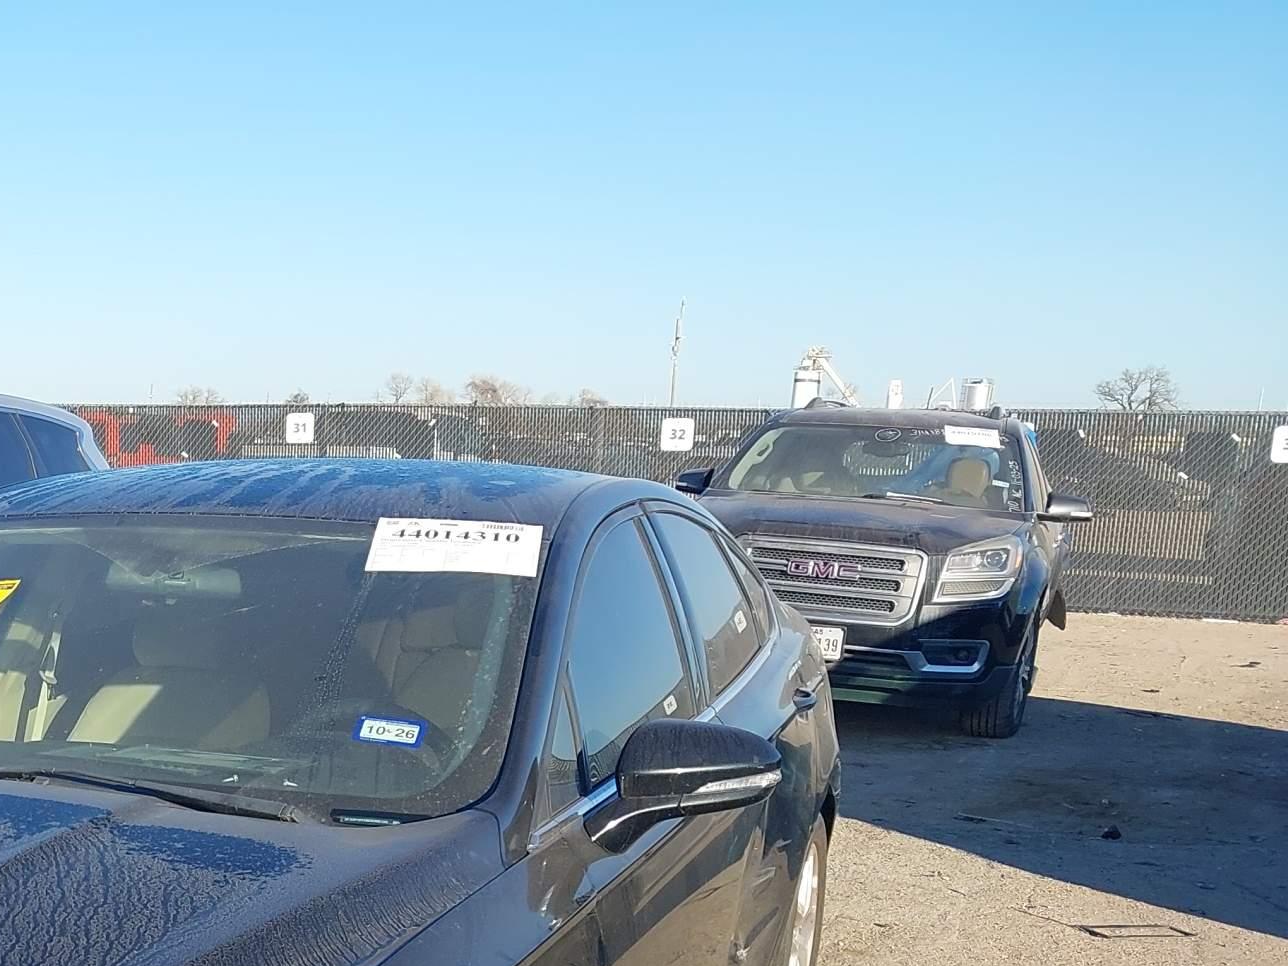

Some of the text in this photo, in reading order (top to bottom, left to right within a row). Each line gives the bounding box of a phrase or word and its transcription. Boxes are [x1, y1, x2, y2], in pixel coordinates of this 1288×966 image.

[293, 422, 307, 433] 31
[669, 428, 687, 440] 32
[392, 528, 521, 544] 44014310
[787, 559, 861, 580] GMC
